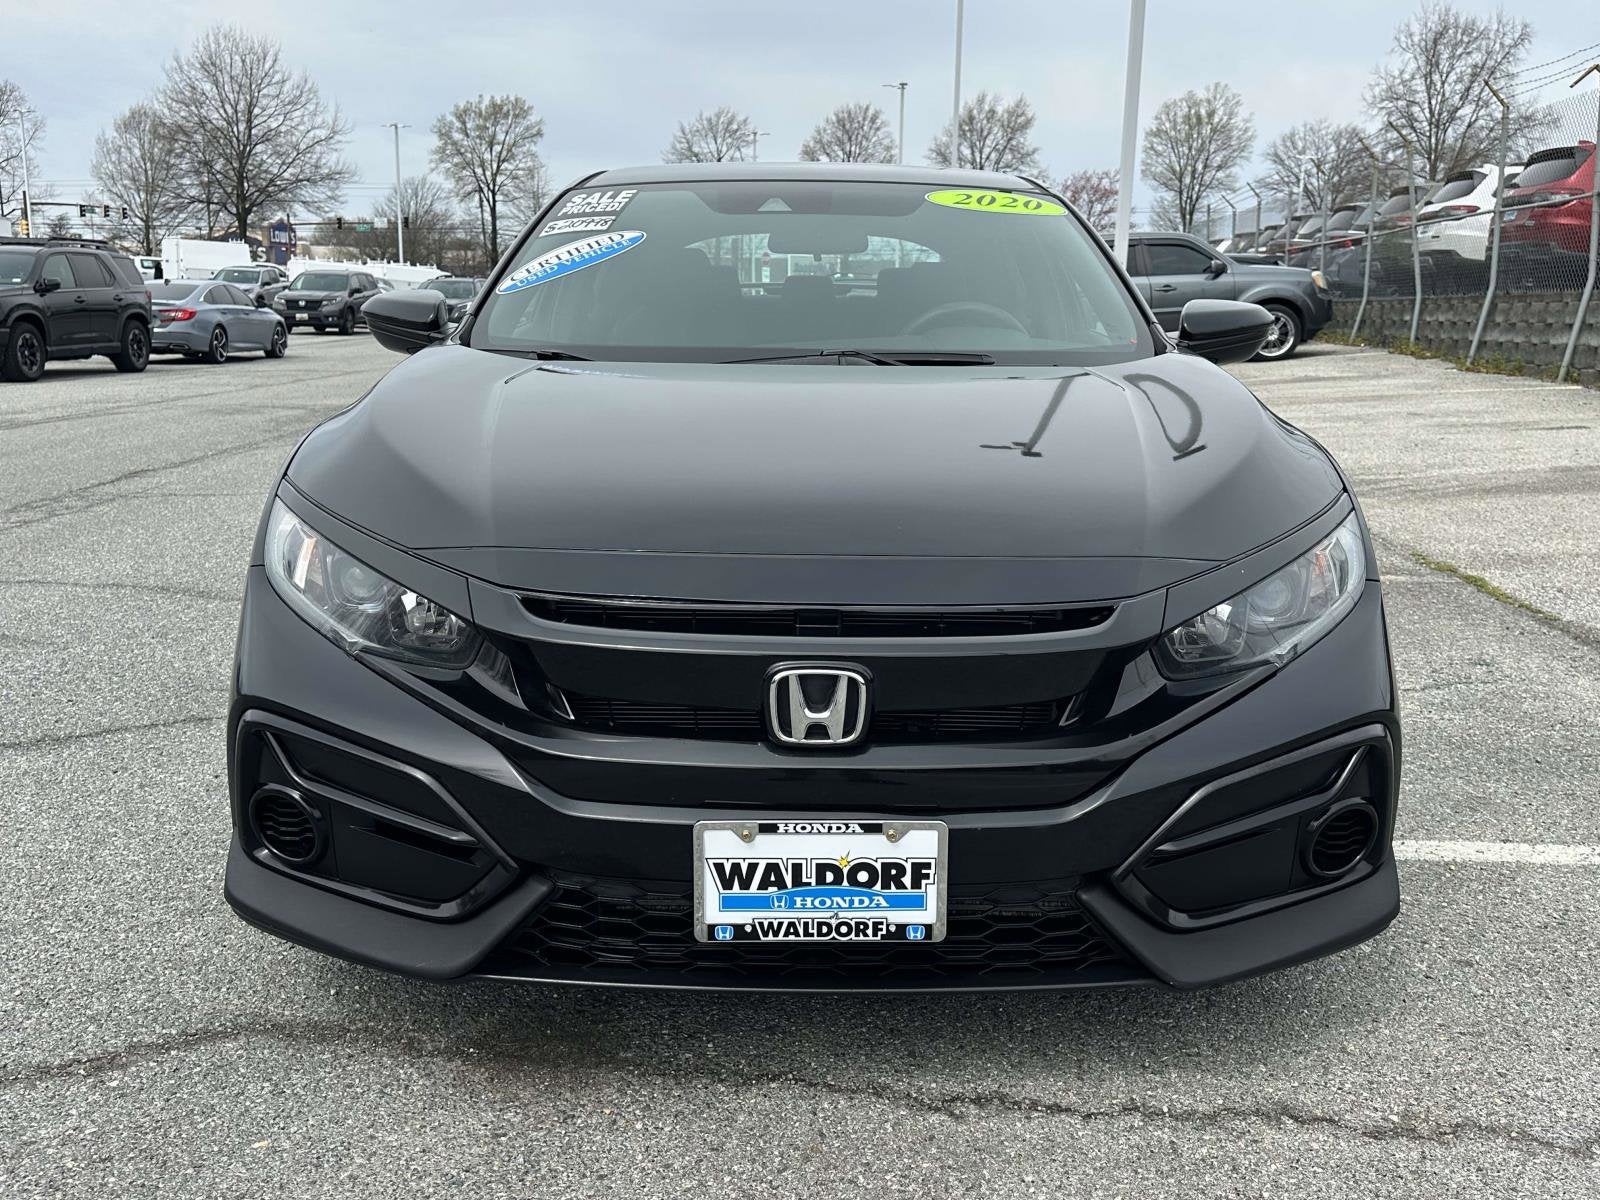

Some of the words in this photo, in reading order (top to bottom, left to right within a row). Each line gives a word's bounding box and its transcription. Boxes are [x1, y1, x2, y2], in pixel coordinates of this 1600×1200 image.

[566, 189, 638, 207] SALE
[953, 193, 1043, 210] 2020
[511, 233, 625, 281] CERTIFIED
[516, 265, 558, 287] USED
[561, 239, 632, 265] VEHICLE
[776, 823, 864, 833] HONDA
[709, 860, 934, 891] WALDORF
[794, 896, 890, 908] HONDA
[754, 919, 886, 939] WALDORF
